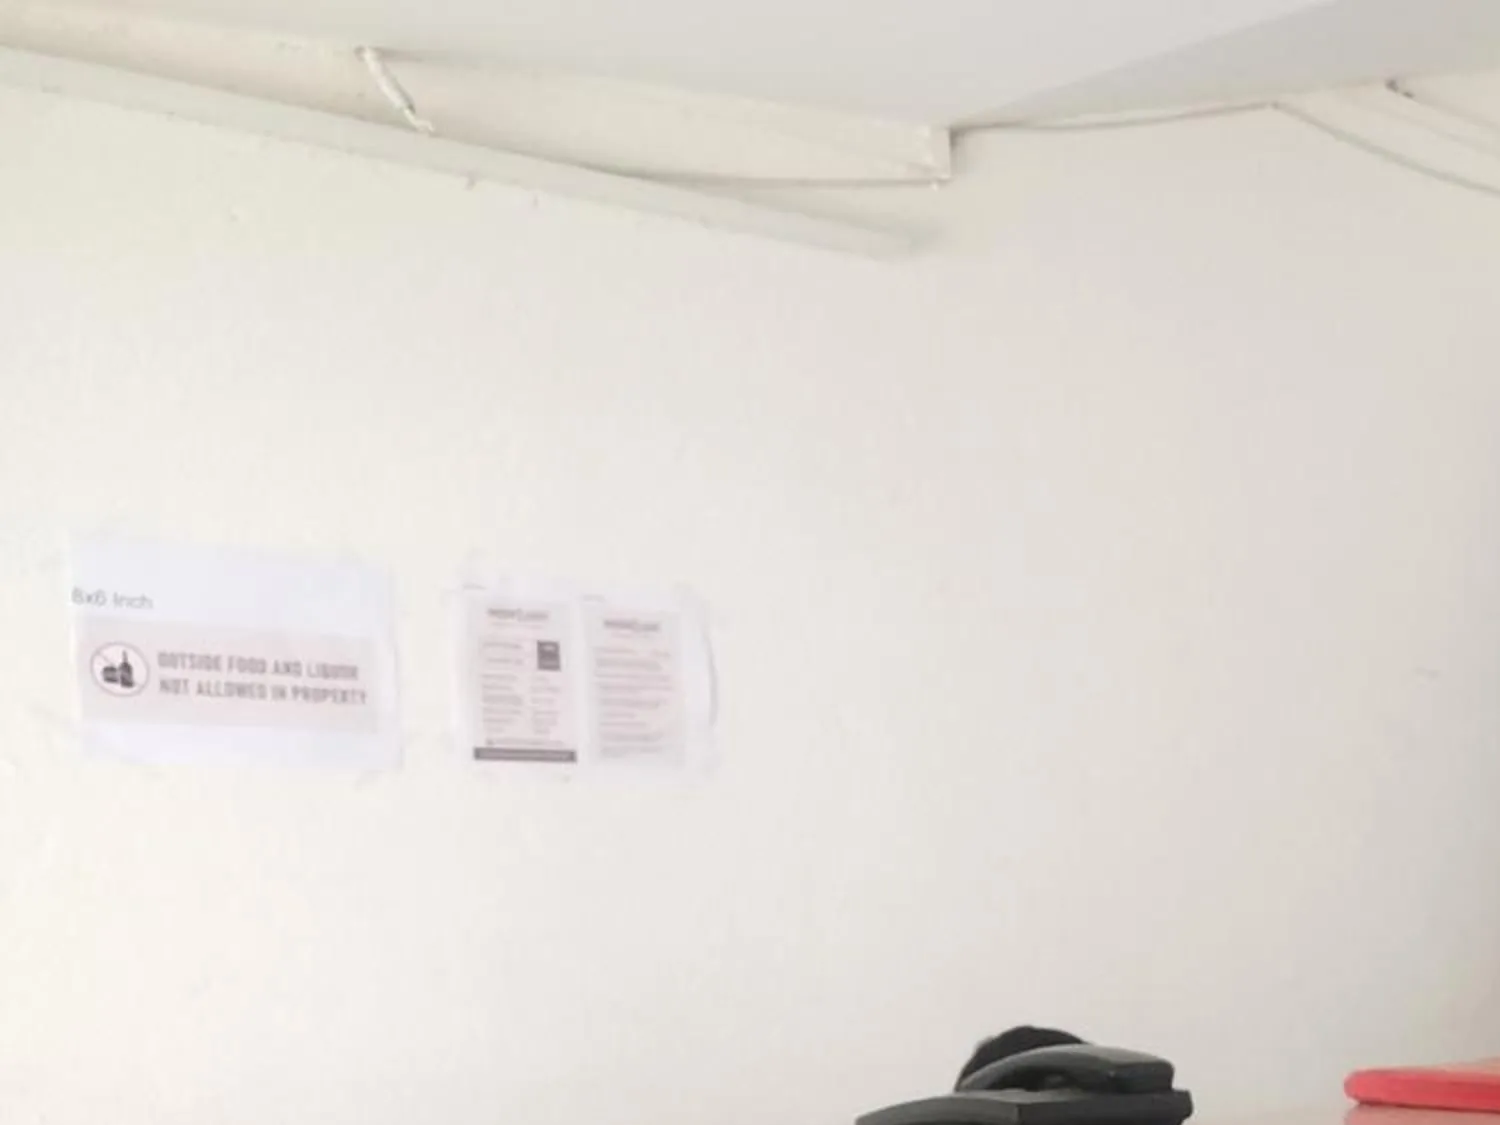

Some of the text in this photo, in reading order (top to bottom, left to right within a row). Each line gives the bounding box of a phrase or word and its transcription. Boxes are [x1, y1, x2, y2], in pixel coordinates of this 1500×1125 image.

[157, 651, 221, 671] OUTSIDE
[227, 655, 267, 675] FOOD
[272, 660, 302, 677] AND
[159, 678, 367, 705] NOT ALLOWED IN PROPERTY
